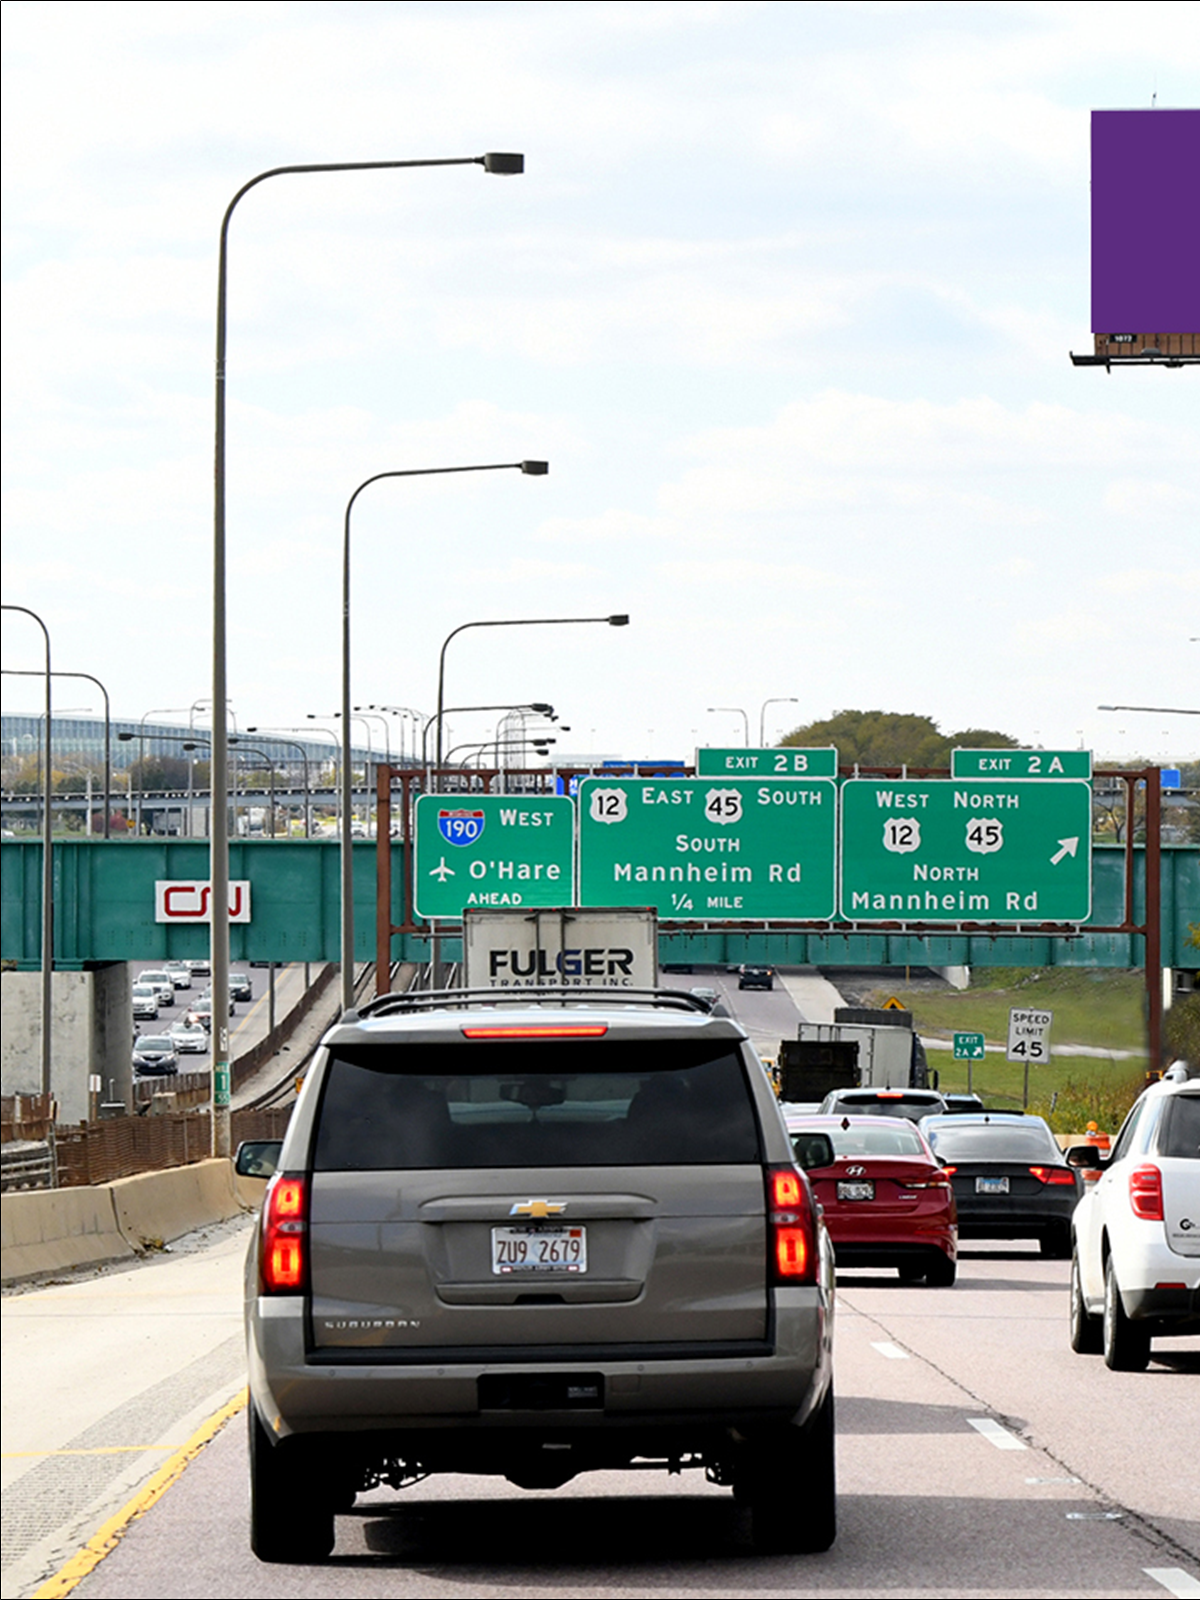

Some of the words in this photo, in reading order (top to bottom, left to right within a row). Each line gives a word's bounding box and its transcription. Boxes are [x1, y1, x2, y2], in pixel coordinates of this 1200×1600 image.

[726, 756, 758, 769] EXIT
[979, 758, 1011, 771] EXIT
[597, 796, 619, 815] 12
[642, 787, 694, 804] EAST
[709, 797, 738, 816] 45
[757, 788, 822, 805] SOUTH
[876, 790, 929, 808] WEST
[954, 791, 1019, 808] NORTH
[500, 809, 553, 827] WEST
[446, 820, 478, 838] 190
[890, 825, 913, 845] 12
[968, 826, 999, 846] 45
[676, 835, 740, 852] SOUTH
[469, 861, 561, 880] O'Hare
[614, 863, 752, 882] Mannheim
[769, 863, 801, 883] Rd
[913, 864, 979, 881] NORTH
[467, 893, 522, 905] AHEAD
[707, 896, 743, 909] MILE
[852, 891, 989, 910] Mannheim
[1006, 891, 1038, 911] Rd
[489, 949, 634, 976] FULGER
[489, 977, 593, 988] TRANSPORT
[602, 977, 634, 987] INC.
[1012, 1012, 1049, 1025] SPEED
[1015, 1026, 1044, 1037] LIMIT
[958, 1036, 978, 1045] EXIT
[1011, 1041, 1043, 1057] 45
[955, 1048, 969, 1057] 2A
[497, 1240, 528, 1263] ZU9
[538, 1239, 581, 1263] 2679
